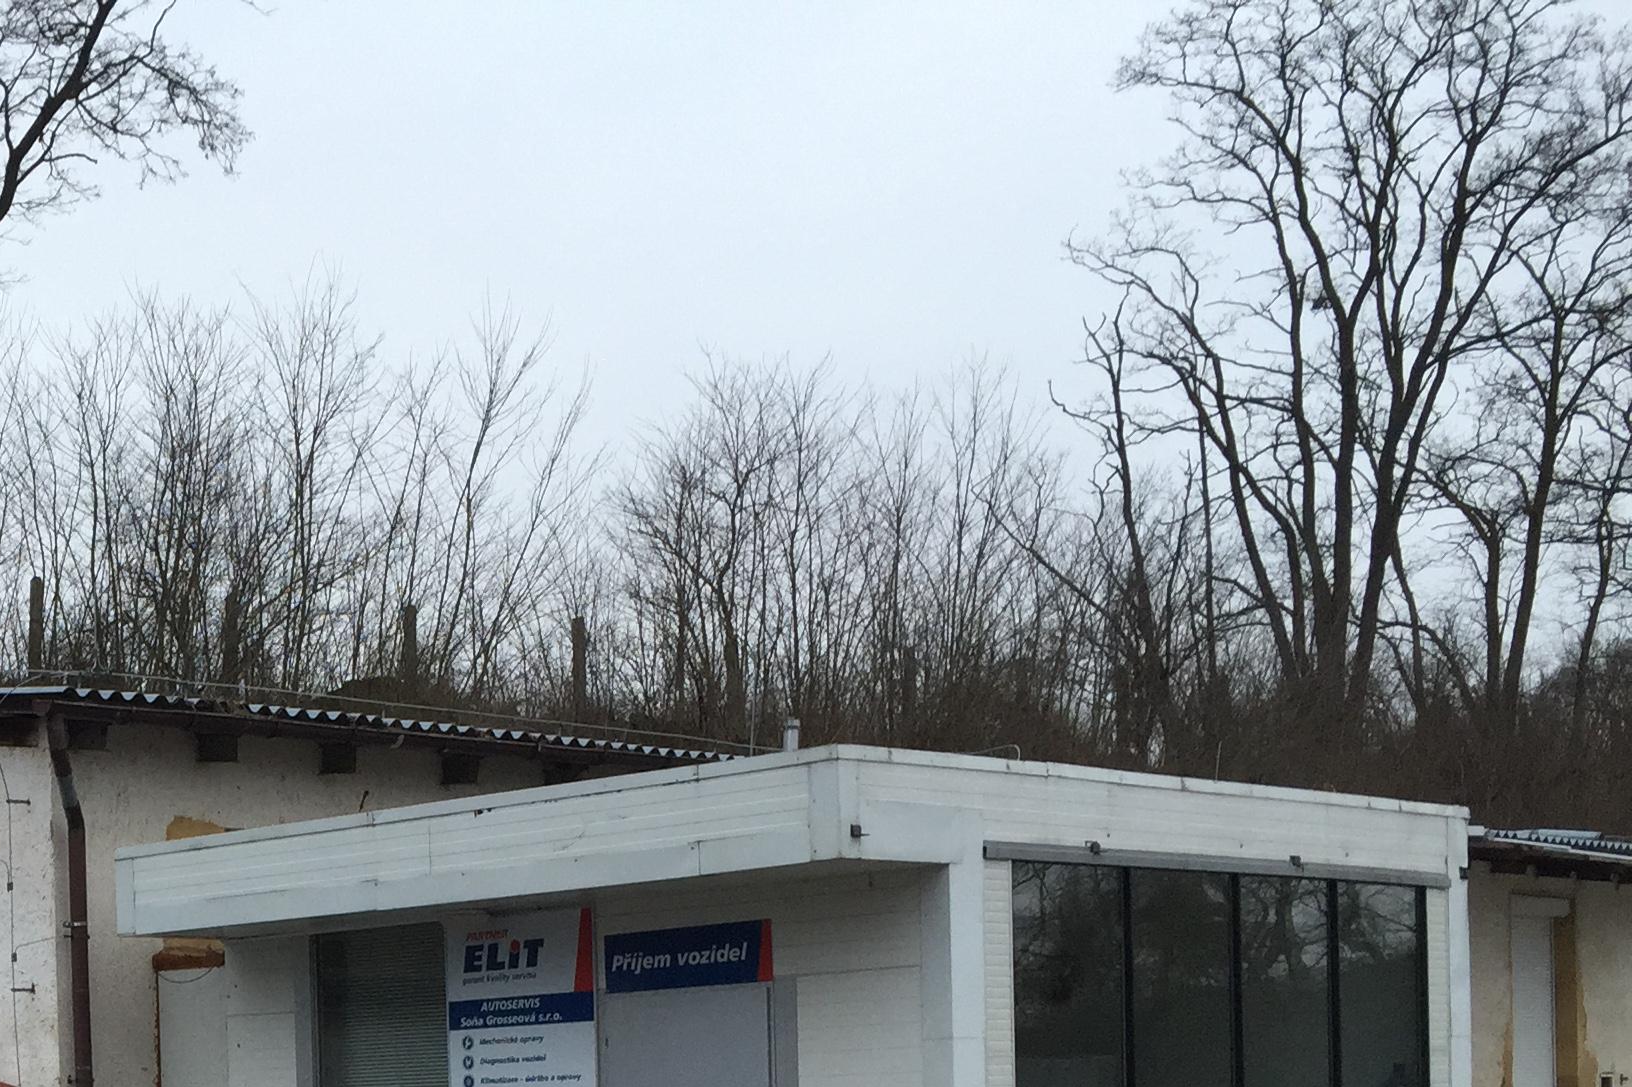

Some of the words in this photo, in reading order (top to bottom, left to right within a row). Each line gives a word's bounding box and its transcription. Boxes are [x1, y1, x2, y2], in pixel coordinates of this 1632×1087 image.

[611, 952, 671, 975] Příjem
[677, 941, 748, 967] vozidel
[480, 998, 541, 1013] AUTOSERVIS
[538, 1010, 563, 1022] s.r.o.
